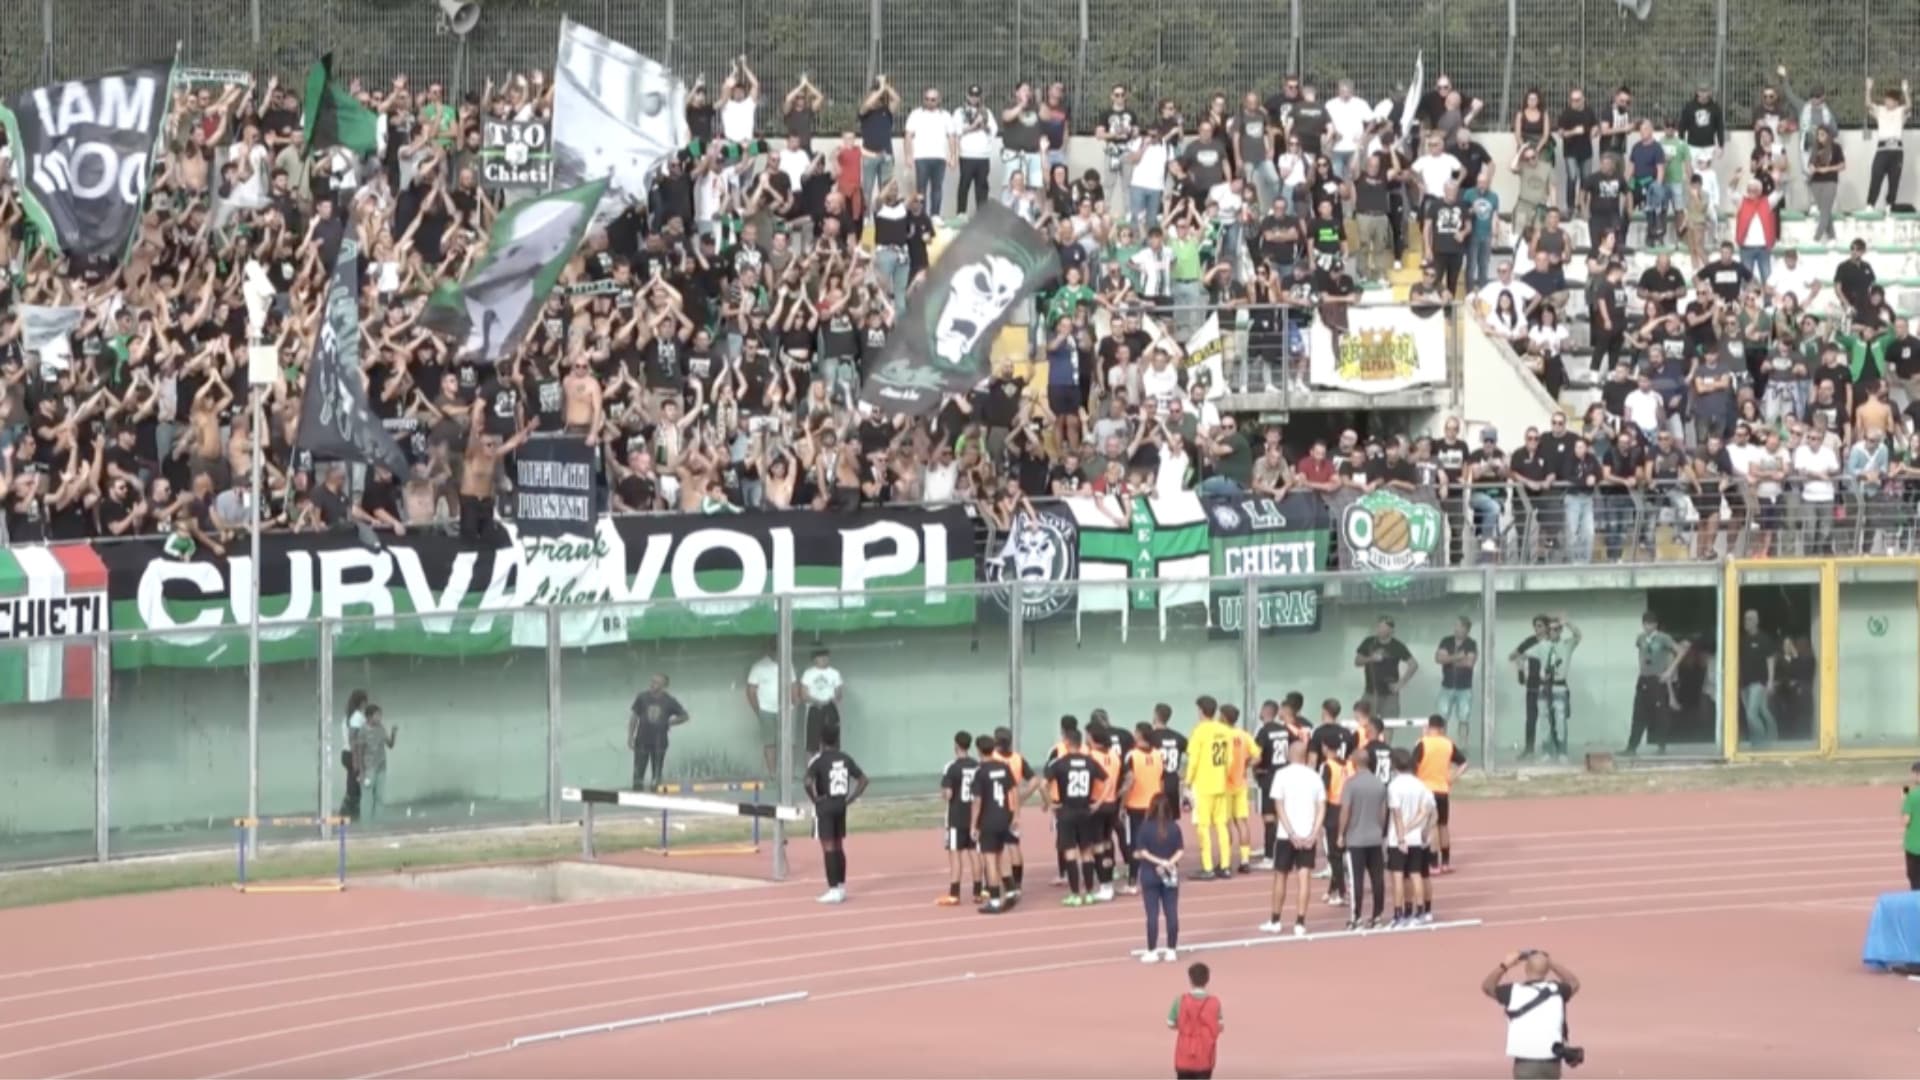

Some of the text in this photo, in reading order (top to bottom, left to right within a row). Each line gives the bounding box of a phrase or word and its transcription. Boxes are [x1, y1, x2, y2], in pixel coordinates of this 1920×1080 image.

[485, 163, 547, 182] Chieti
[1241, 498, 1287, 529] LA
[522, 530, 610, 566] Frank
[1225, 541, 1316, 577] CHIETI
[622, 520, 947, 617] VOLPI
[1219, 590, 1318, 630] UTRAS
[993, 780, 1005, 808] 4
[1067, 769, 1090, 797] 29
